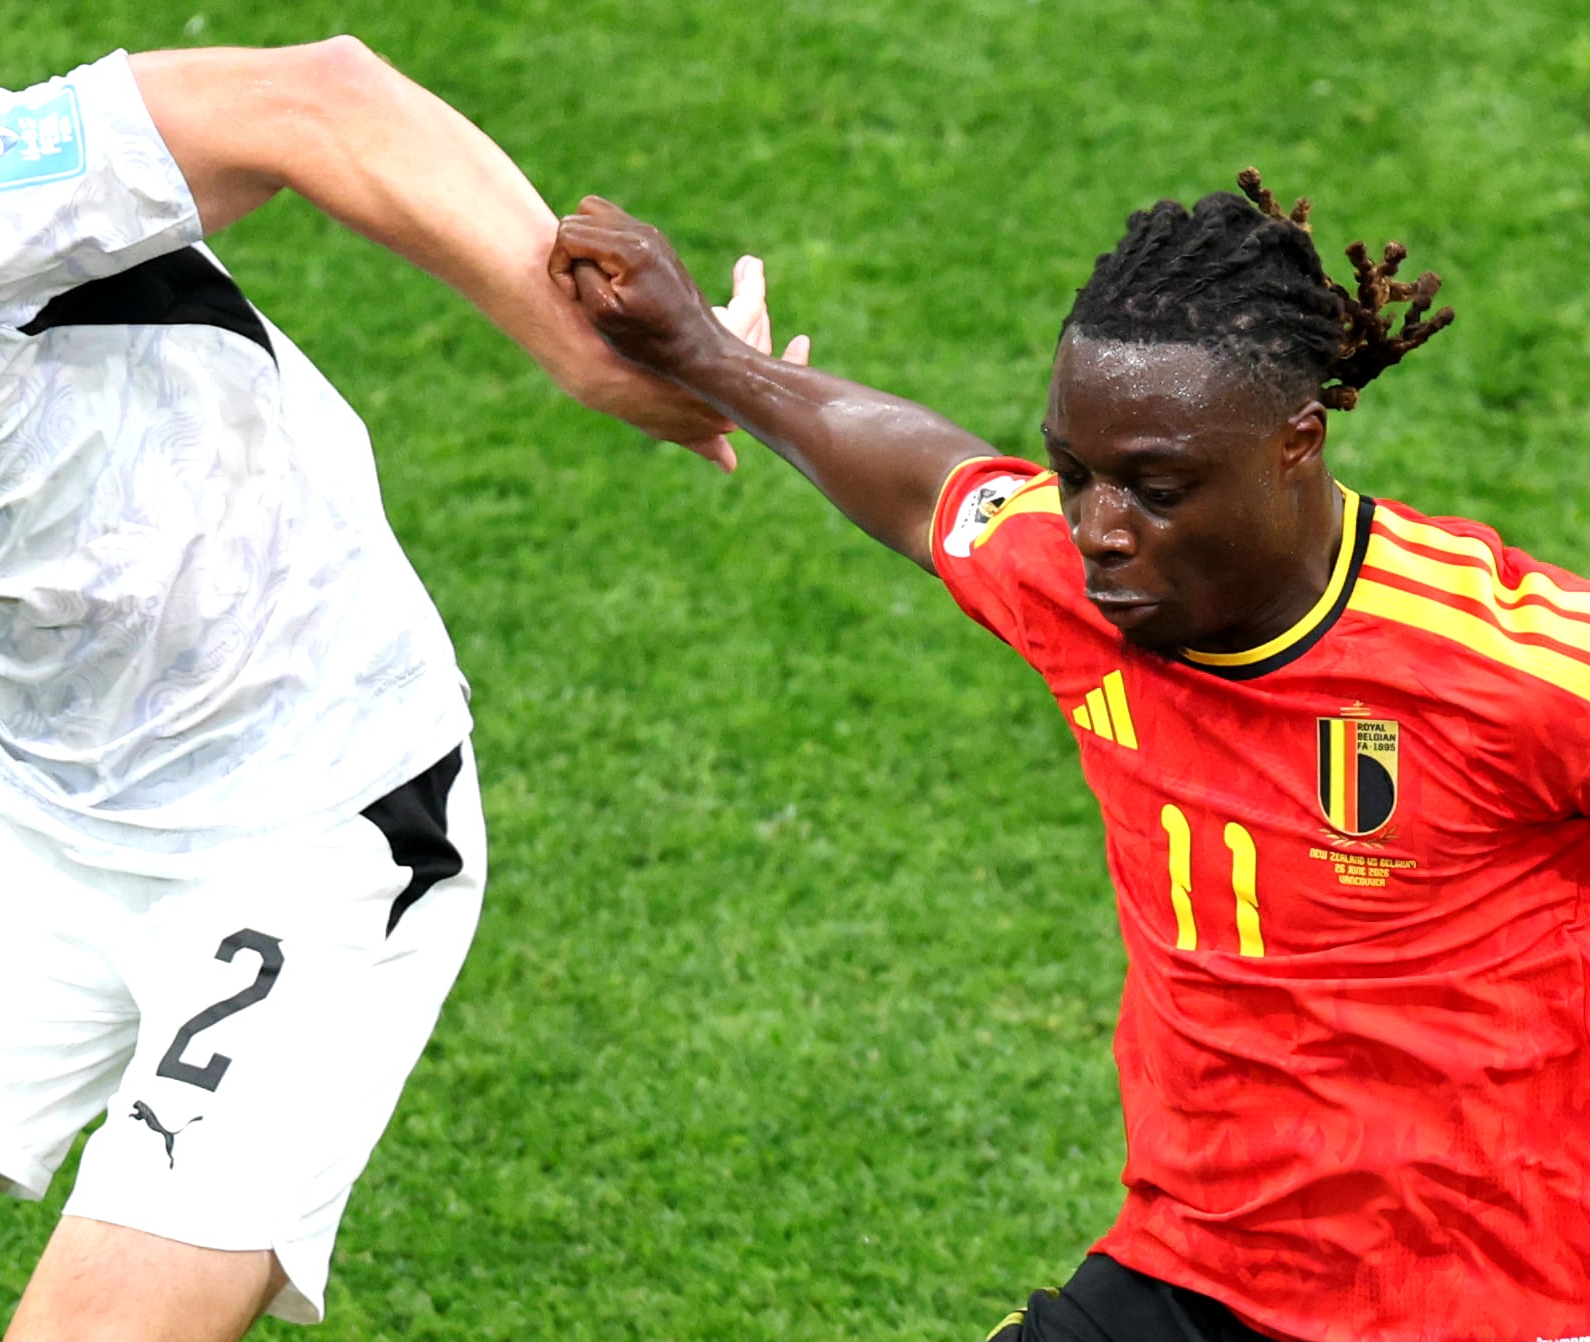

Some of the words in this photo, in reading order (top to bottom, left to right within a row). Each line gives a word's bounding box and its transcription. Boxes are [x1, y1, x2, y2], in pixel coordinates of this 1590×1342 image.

[1357, 723, 1386, 732] ROYAL
[1357, 732, 1396, 741] BELGIAN
[1357, 742, 1368, 751] FA
[1160, 803, 1265, 959] 11
[155, 927, 285, 1093] 2
